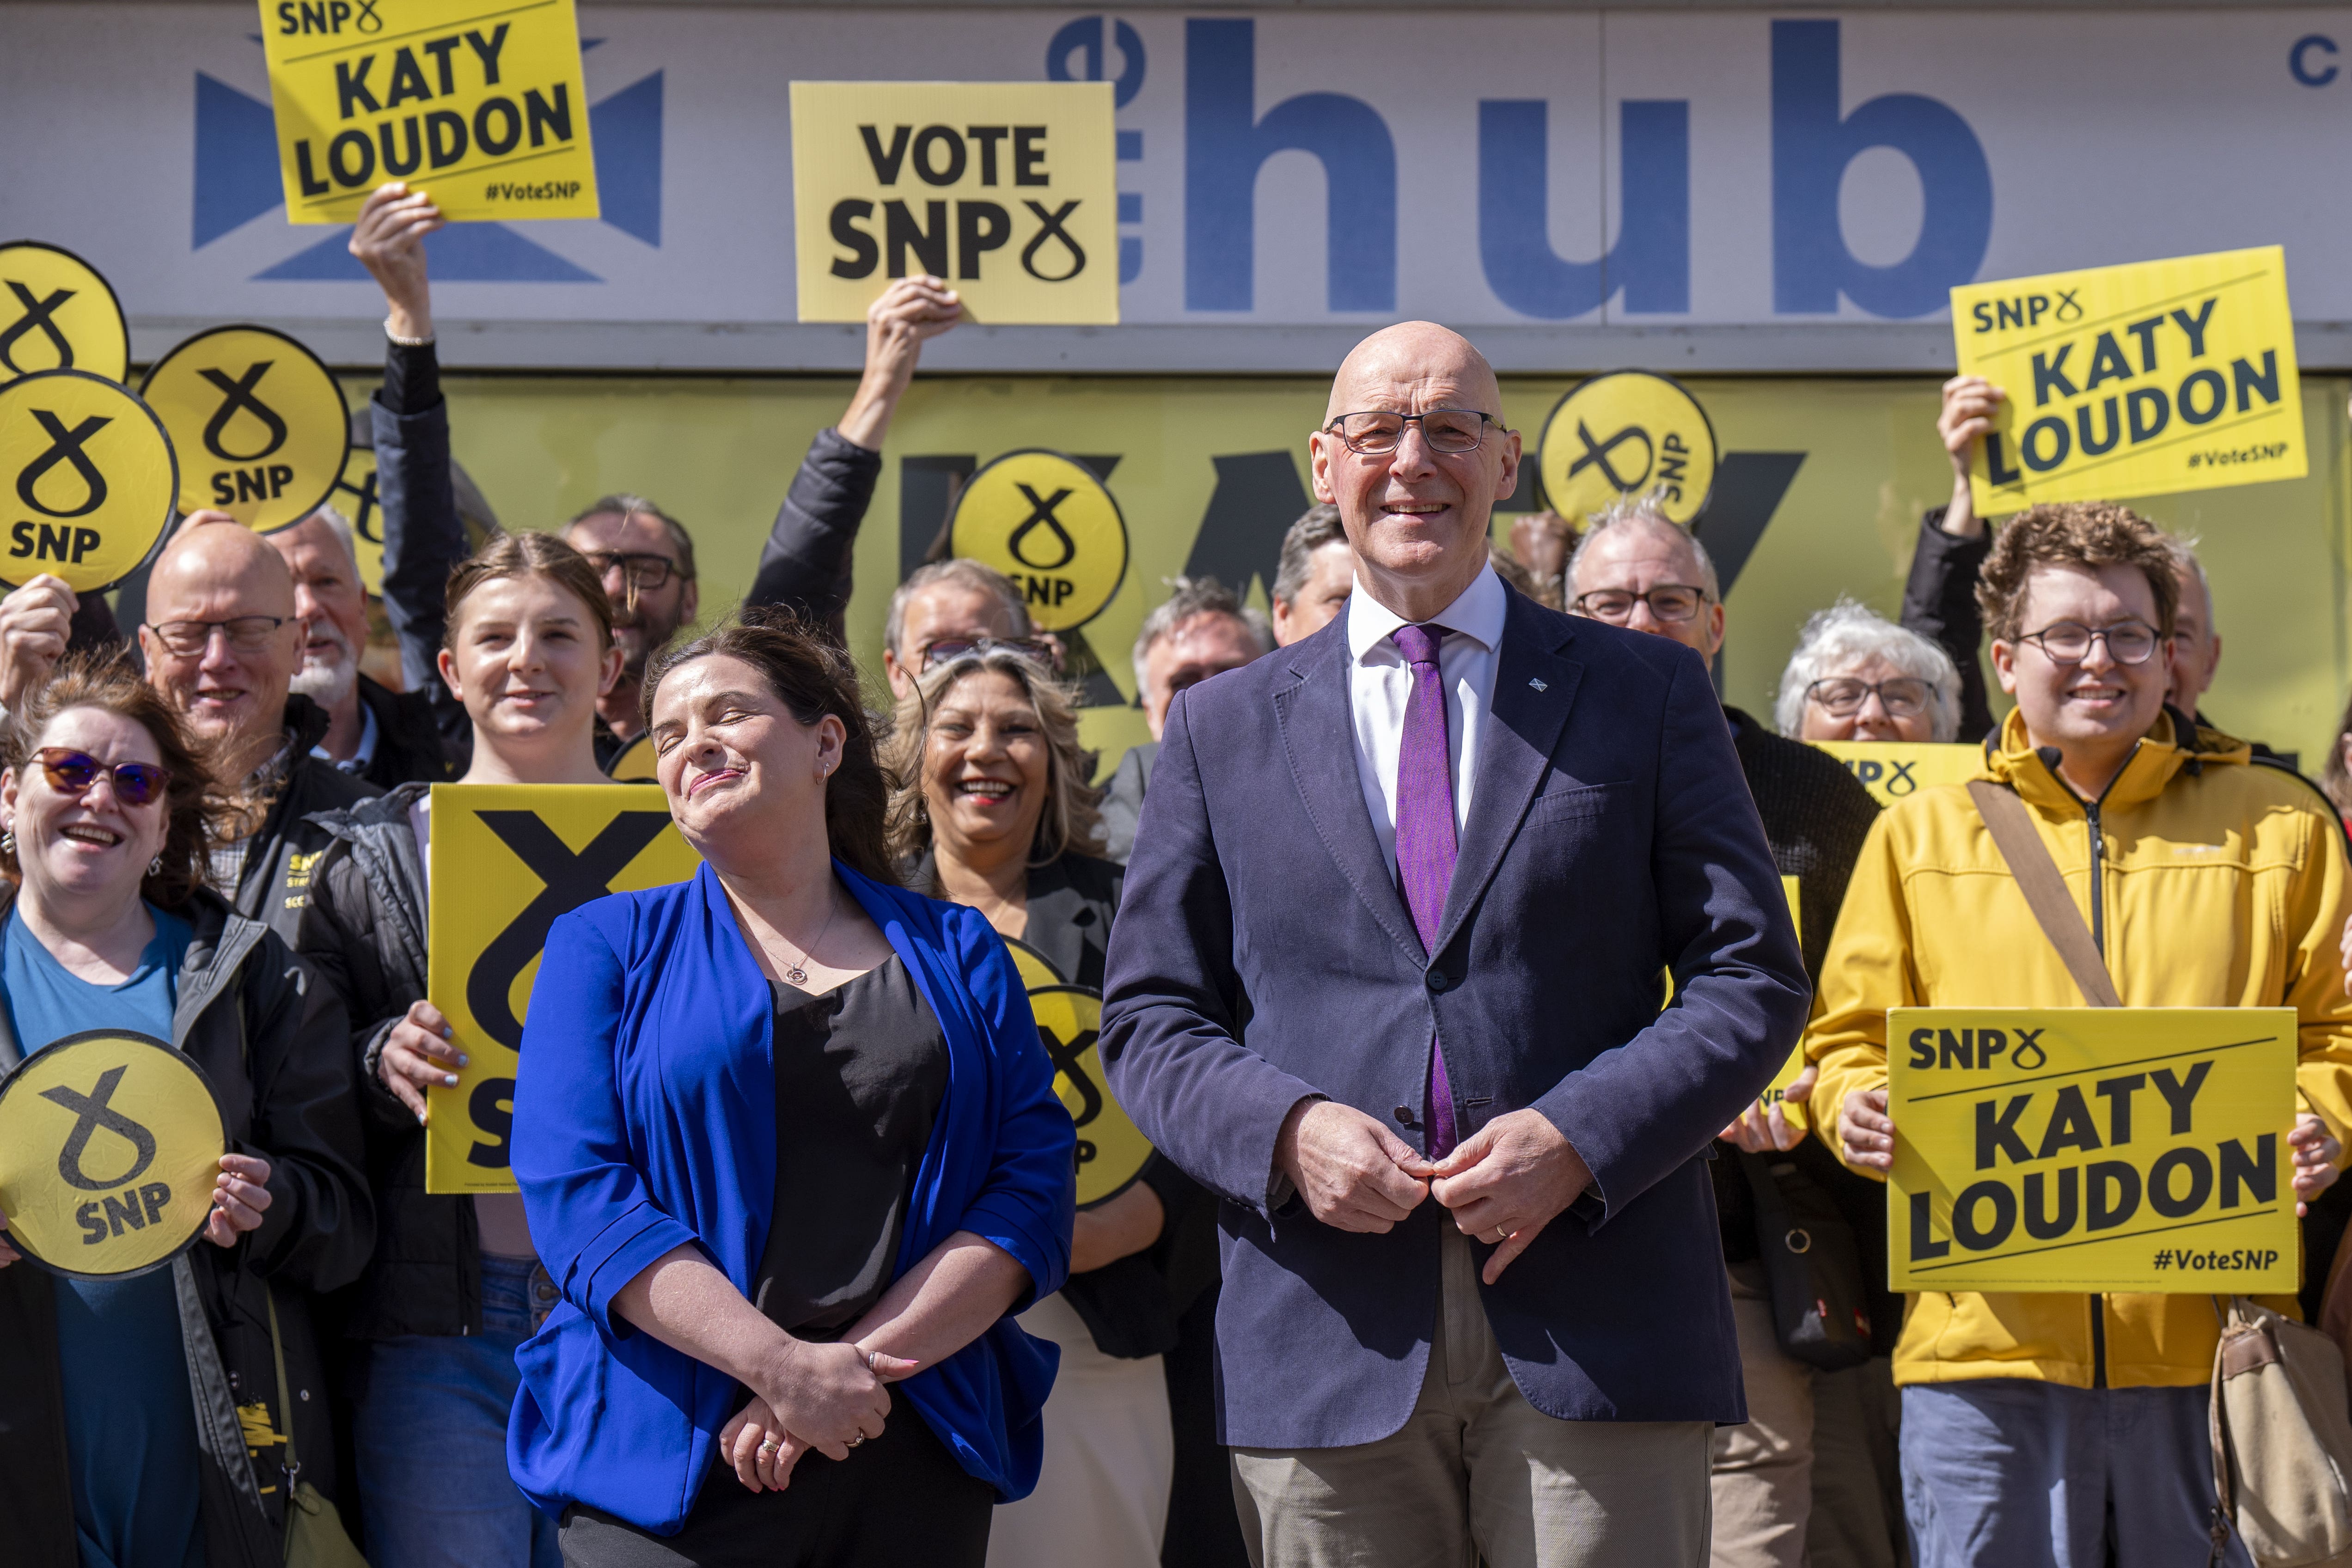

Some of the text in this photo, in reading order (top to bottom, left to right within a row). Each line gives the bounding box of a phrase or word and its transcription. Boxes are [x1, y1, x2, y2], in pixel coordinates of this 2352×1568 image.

[278, 1, 351, 35] SNP
[335, 22, 511, 120] KATY
[294, 83, 573, 198] LOUDON
[858, 125, 1050, 187] VOTE
[1183, 18, 1993, 319] hub
[485, 181, 581, 201] #VoteSNP
[829, 198, 1012, 280] SNP
[1973, 294, 2049, 333] SNP
[2032, 298, 2217, 407] KATY
[1985, 349, 2280, 487] LOUDON
[211, 464, 294, 506] SNP
[2187, 442, 2289, 469] #VoteSNP
[9, 521, 101, 564] SNP
[1908, 1028, 2008, 1069] SNP
[1975, 1060, 2214, 1171] KATY
[75, 1182, 171, 1245] SNP
[1909, 1132, 2277, 1263] LOUDON
[2153, 1249, 2279, 1271] #VoteSNP
